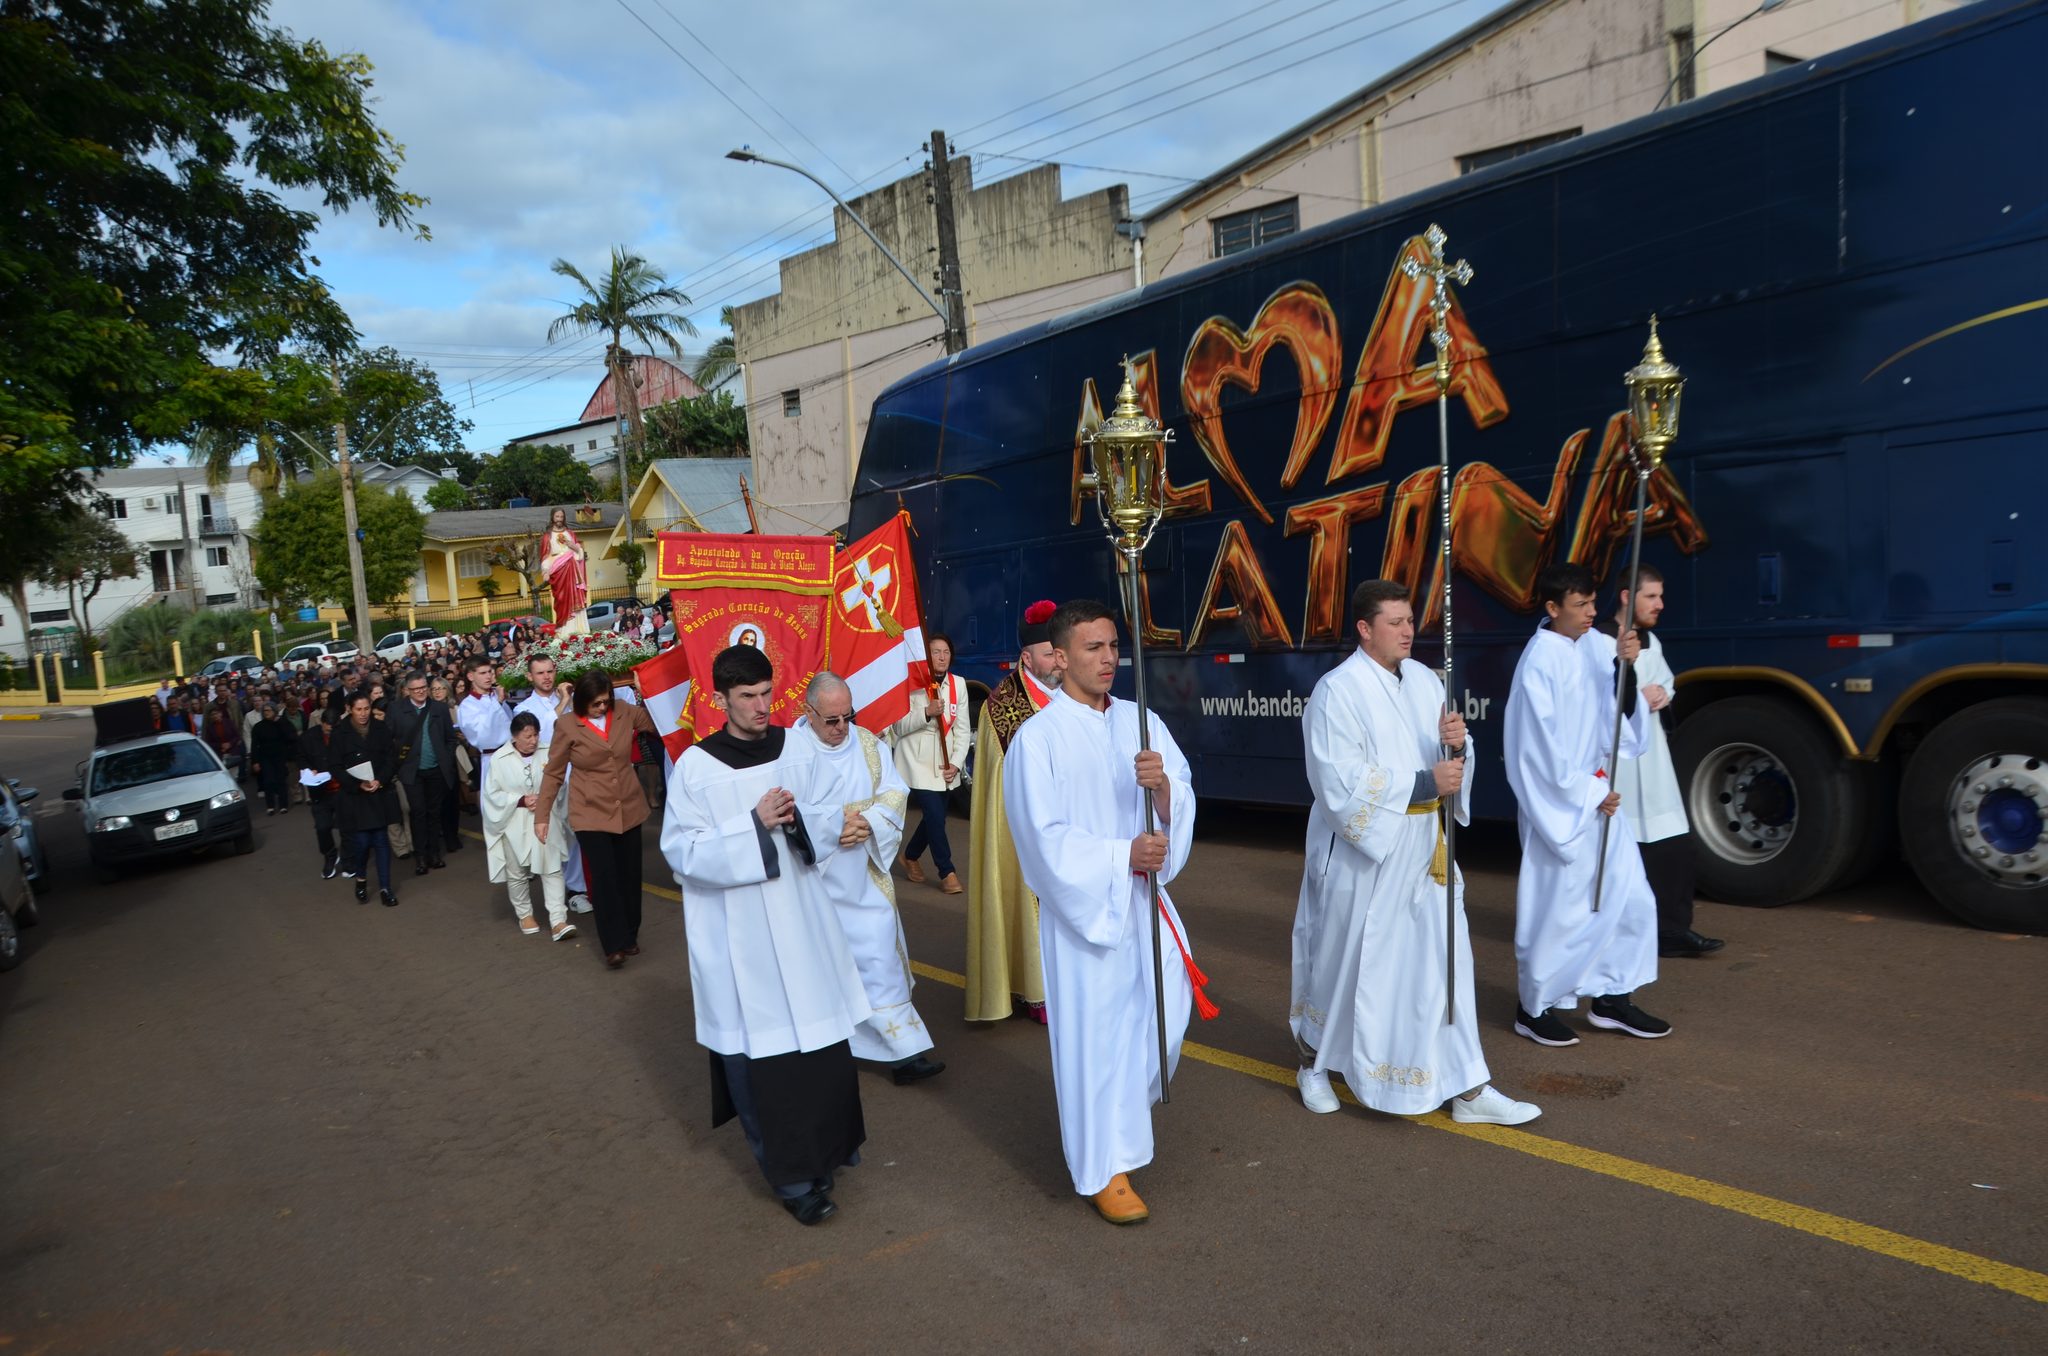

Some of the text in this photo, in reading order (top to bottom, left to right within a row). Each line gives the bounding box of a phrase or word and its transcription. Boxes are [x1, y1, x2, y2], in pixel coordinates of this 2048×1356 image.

[1114, 410, 1708, 652] LATINA
[689, 544, 806, 562] Apostolado da Oração
[689, 556, 713, 568] Sagrado
[716, 558, 738, 571] Coração
[751, 560, 768, 570] Jesus
[780, 560, 795, 571] Vista
[798, 560, 816, 572] Alegre
[683, 602, 808, 640] Sagrado Coração de Jesus
[785, 671, 816, 701] Reino
